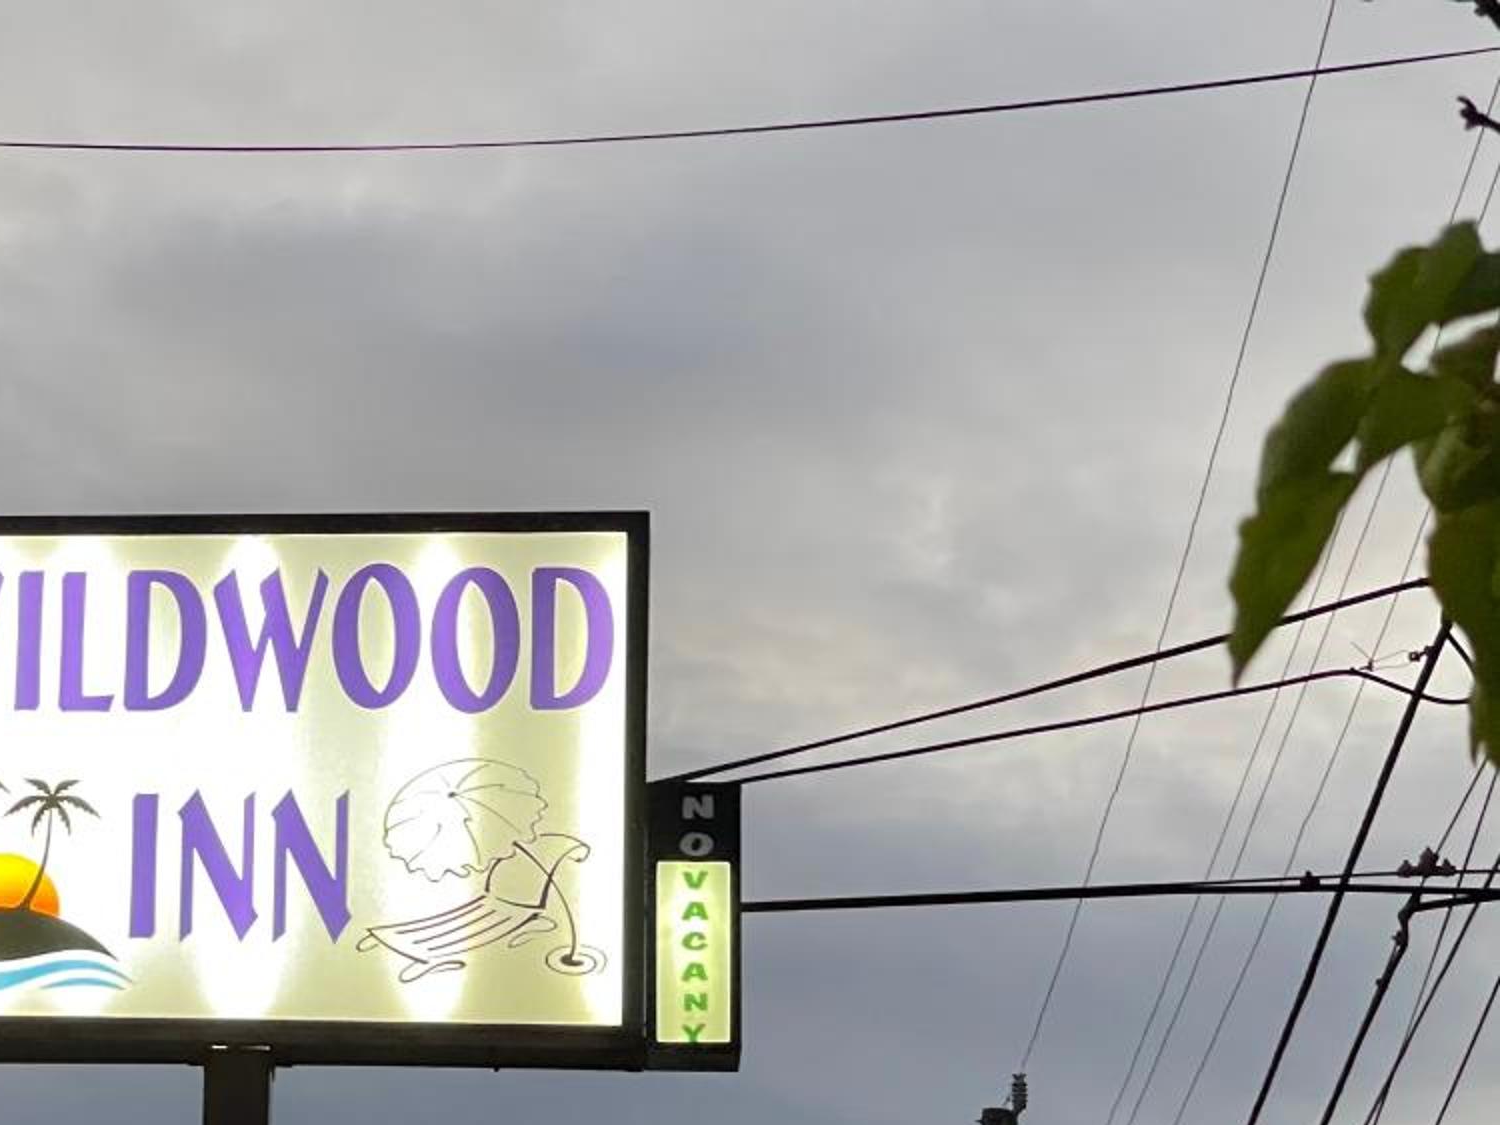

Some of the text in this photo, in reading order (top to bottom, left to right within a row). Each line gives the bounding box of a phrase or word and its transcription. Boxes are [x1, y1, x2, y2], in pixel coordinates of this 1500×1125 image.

[128, 788, 352, 943] INN
[679, 794, 715, 1043] NO VACANY
